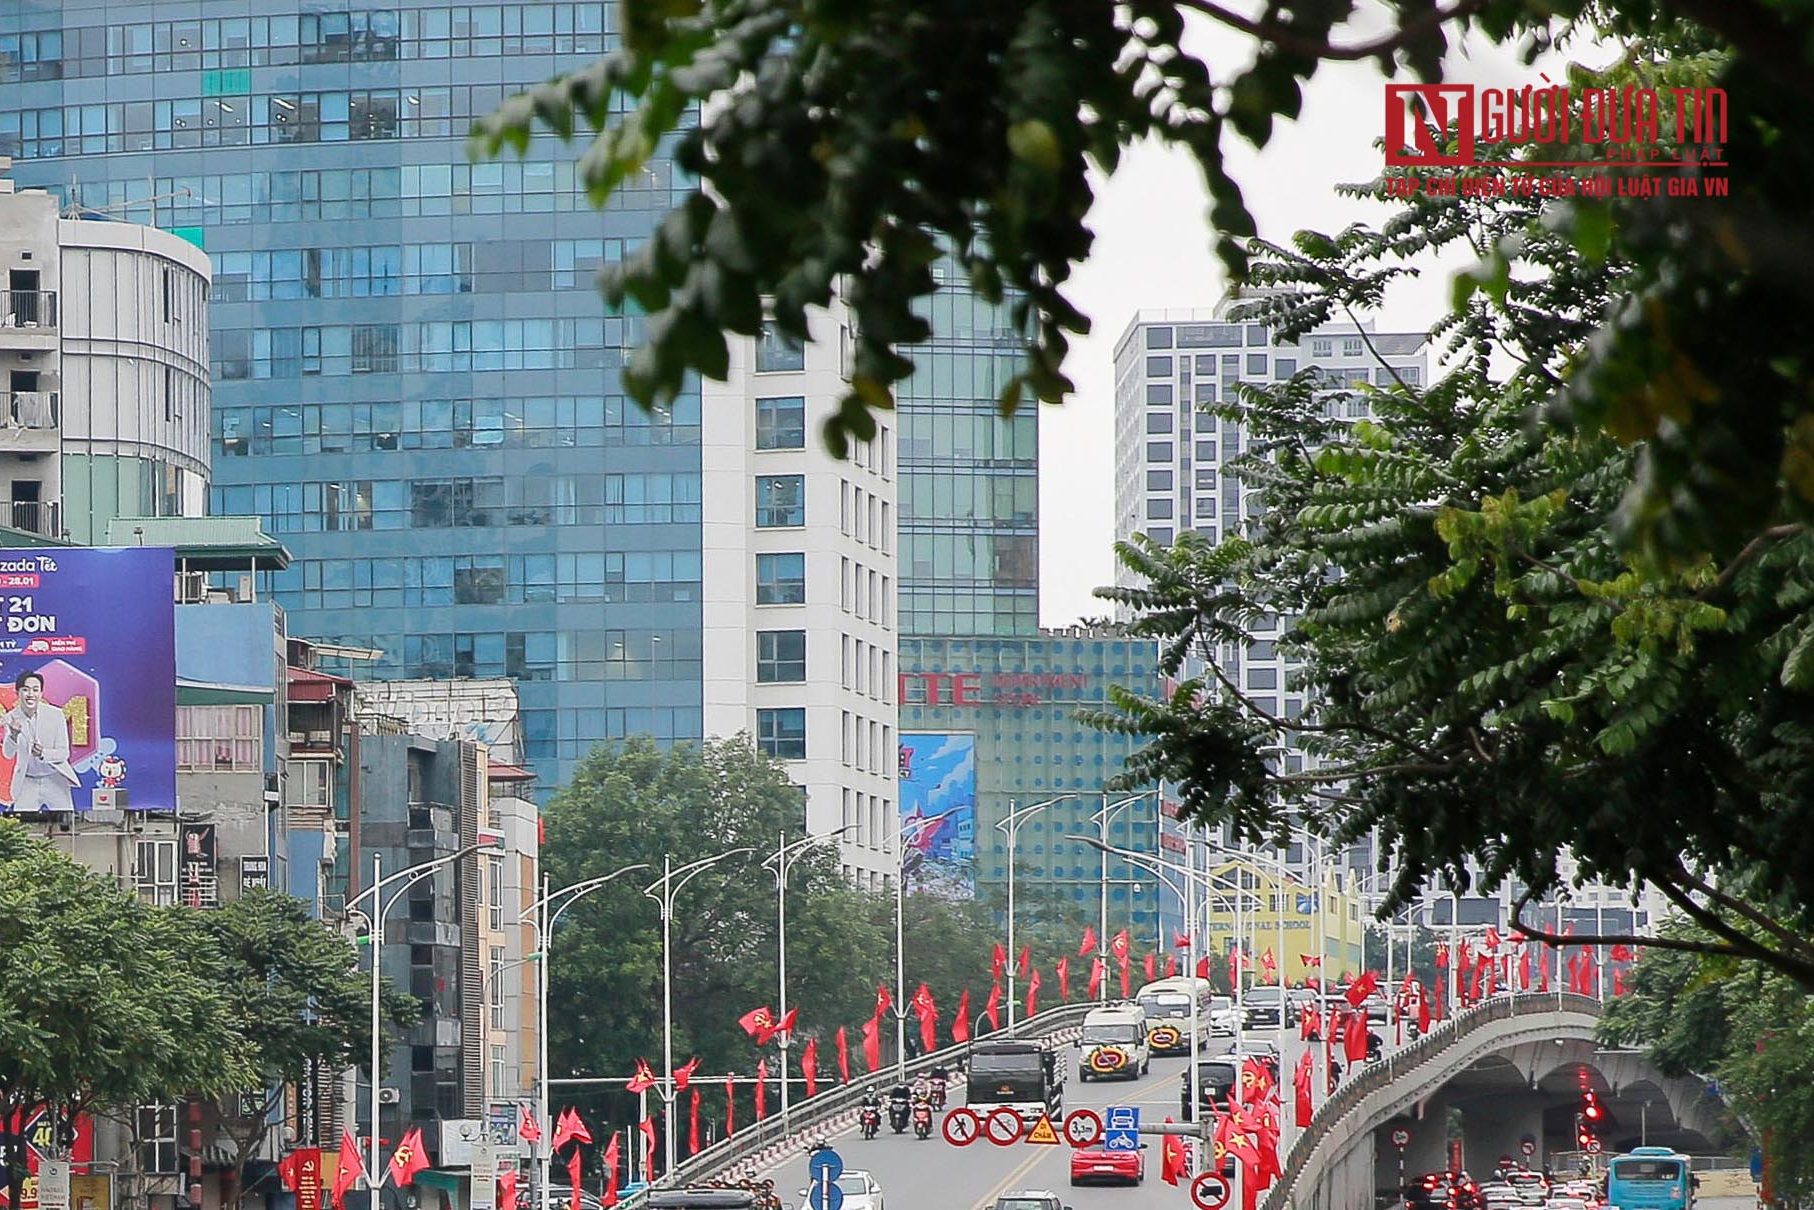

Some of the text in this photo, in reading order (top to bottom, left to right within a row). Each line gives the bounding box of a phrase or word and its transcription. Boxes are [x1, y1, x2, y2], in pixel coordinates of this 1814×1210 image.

[8, 577, 34, 586] 28.01
[9, 597, 32, 612] 21
[7, 614, 56, 632] ĐƠN
